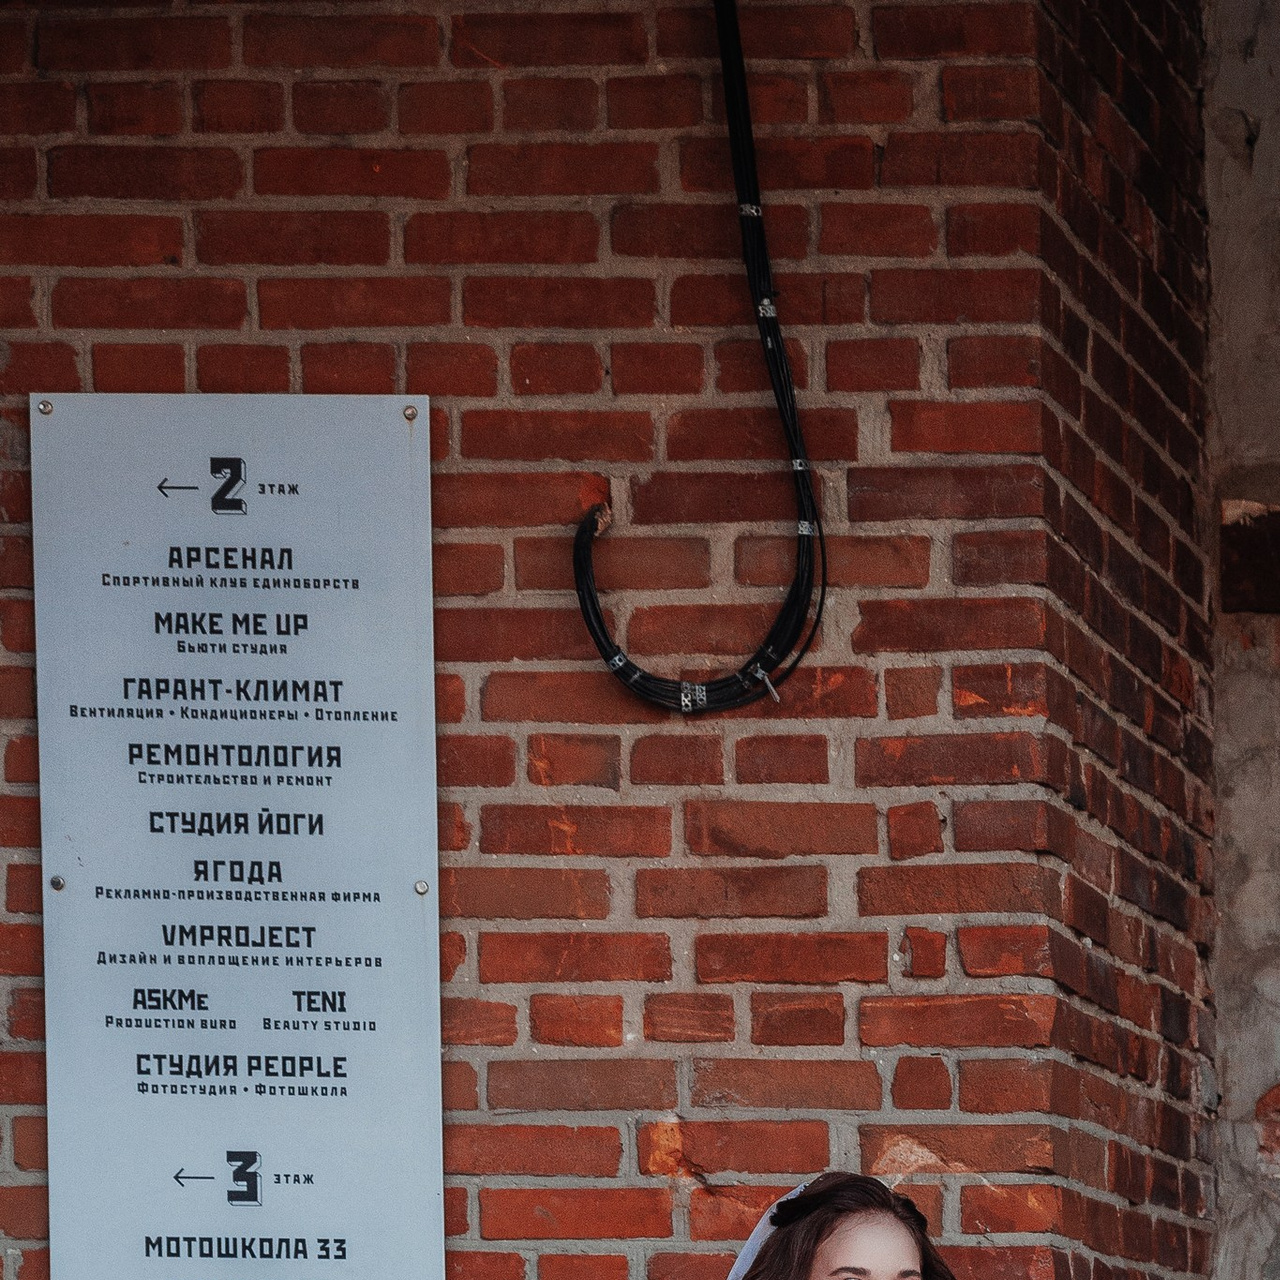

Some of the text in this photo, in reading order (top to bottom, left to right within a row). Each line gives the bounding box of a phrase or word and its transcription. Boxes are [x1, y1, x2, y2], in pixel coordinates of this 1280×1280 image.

[209, 456, 299, 515] 2 ЭТАЖ
[168, 546, 292, 570] АРСЕНАЛ
[101, 573, 359, 589] Спортивный клуб единоборств
[154, 611, 308, 635] MAKE ME UP
[176, 639, 287, 655] Бьюти студия
[123, 677, 343, 702] ГАРАНТ-КЛИМАТ
[69, 704, 397, 721] Вентиляция Кондиционеры Отопление
[128, 742, 341, 767] РЕМОНТОЛОГИЯ
[137, 770, 332, 786] Строительство и ремонт
[149, 807, 323, 836] СТУДИЯ ЙОГИ
[193, 859, 282, 885] ЯГОДА
[95, 886, 380, 902] Рекламно-производственная фирма
[161, 924, 316, 948] VMPROJECT
[96, 951, 381, 967] Дизайн и воплощение интерьеров
[132, 988, 208, 1010] ASKMe
[291, 990, 346, 1012] TENI
[105, 1015, 236, 1029] Production buro
[262, 1017, 375, 1031] Beauty studio
[136, 1053, 347, 1078] СТУДИЯ PEOPLE
[137, 1080, 347, 1096] Фотостудия Фотошкола
[226, 1150, 314, 1206] 3 ЭТАЖ
[144, 1236, 346, 1259] МОТОШКОЛА 33
